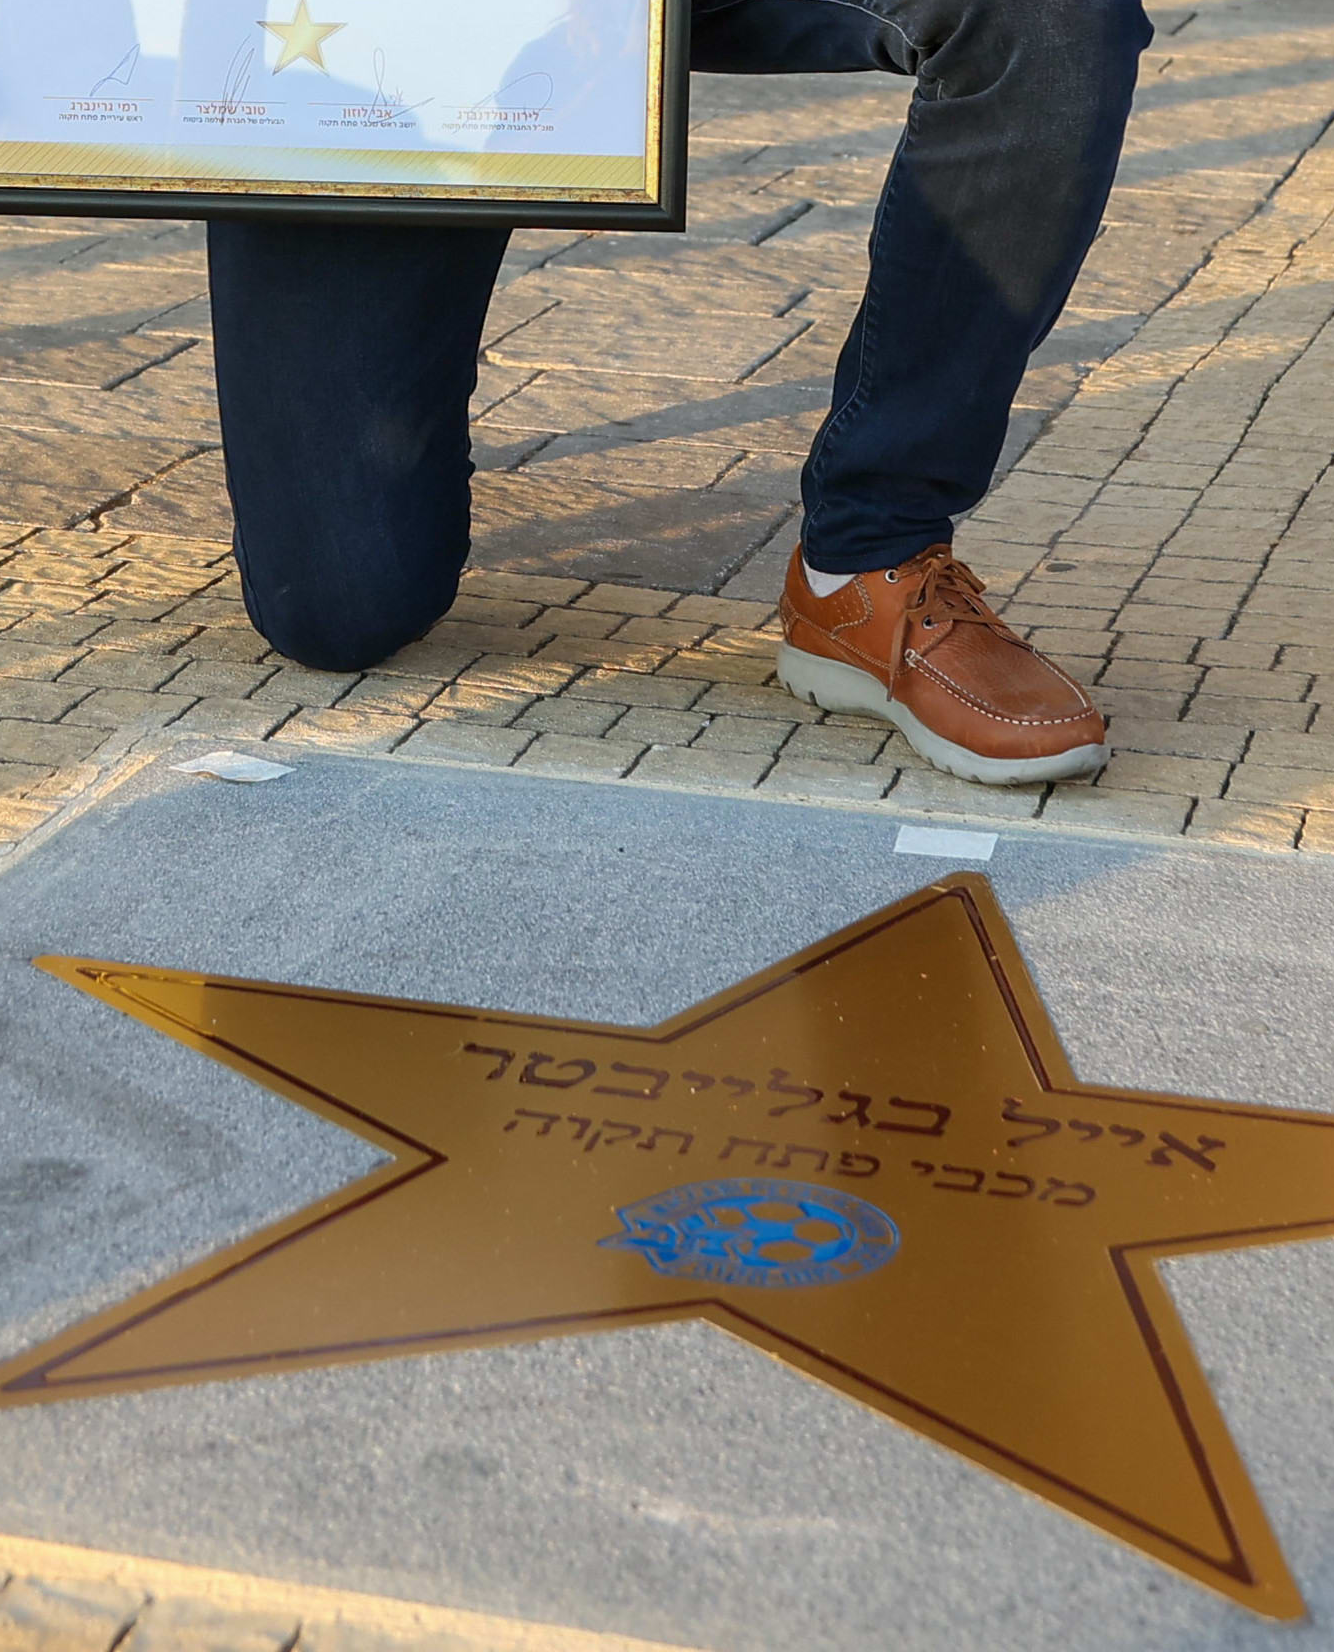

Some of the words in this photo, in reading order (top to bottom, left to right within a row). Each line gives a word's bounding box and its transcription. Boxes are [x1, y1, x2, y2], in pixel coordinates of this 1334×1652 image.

[463, 1041, 953, 1138] בגלייבטר
[503, 1106, 695, 1156] תקוה
[718, 1134, 882, 1178] פתח
[1000, 1096, 1227, 1172] אייל
[910, 1158, 1097, 1208] מכבי
